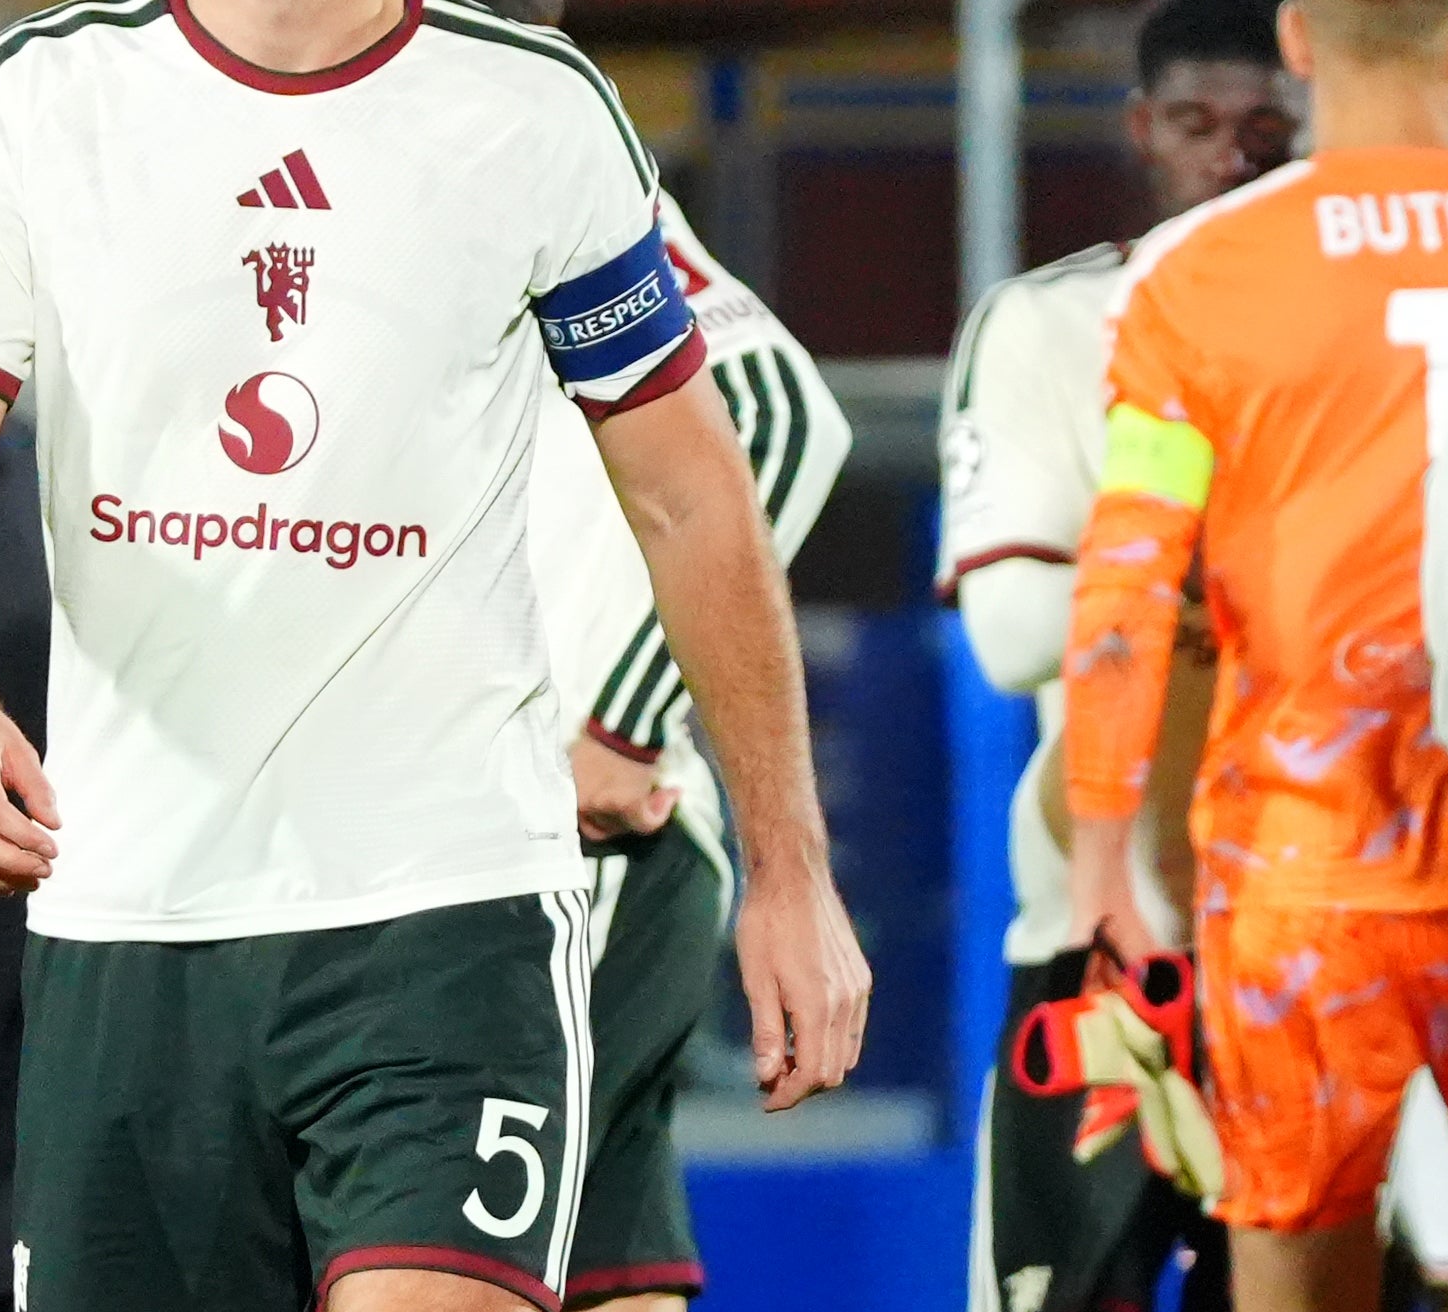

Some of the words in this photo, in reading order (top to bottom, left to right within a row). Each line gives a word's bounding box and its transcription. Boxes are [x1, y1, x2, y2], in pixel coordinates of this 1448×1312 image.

[568, 276, 662, 343] RESPECT
[89, 494, 428, 570] Snapdragon
[461, 1097, 550, 1240] 5
